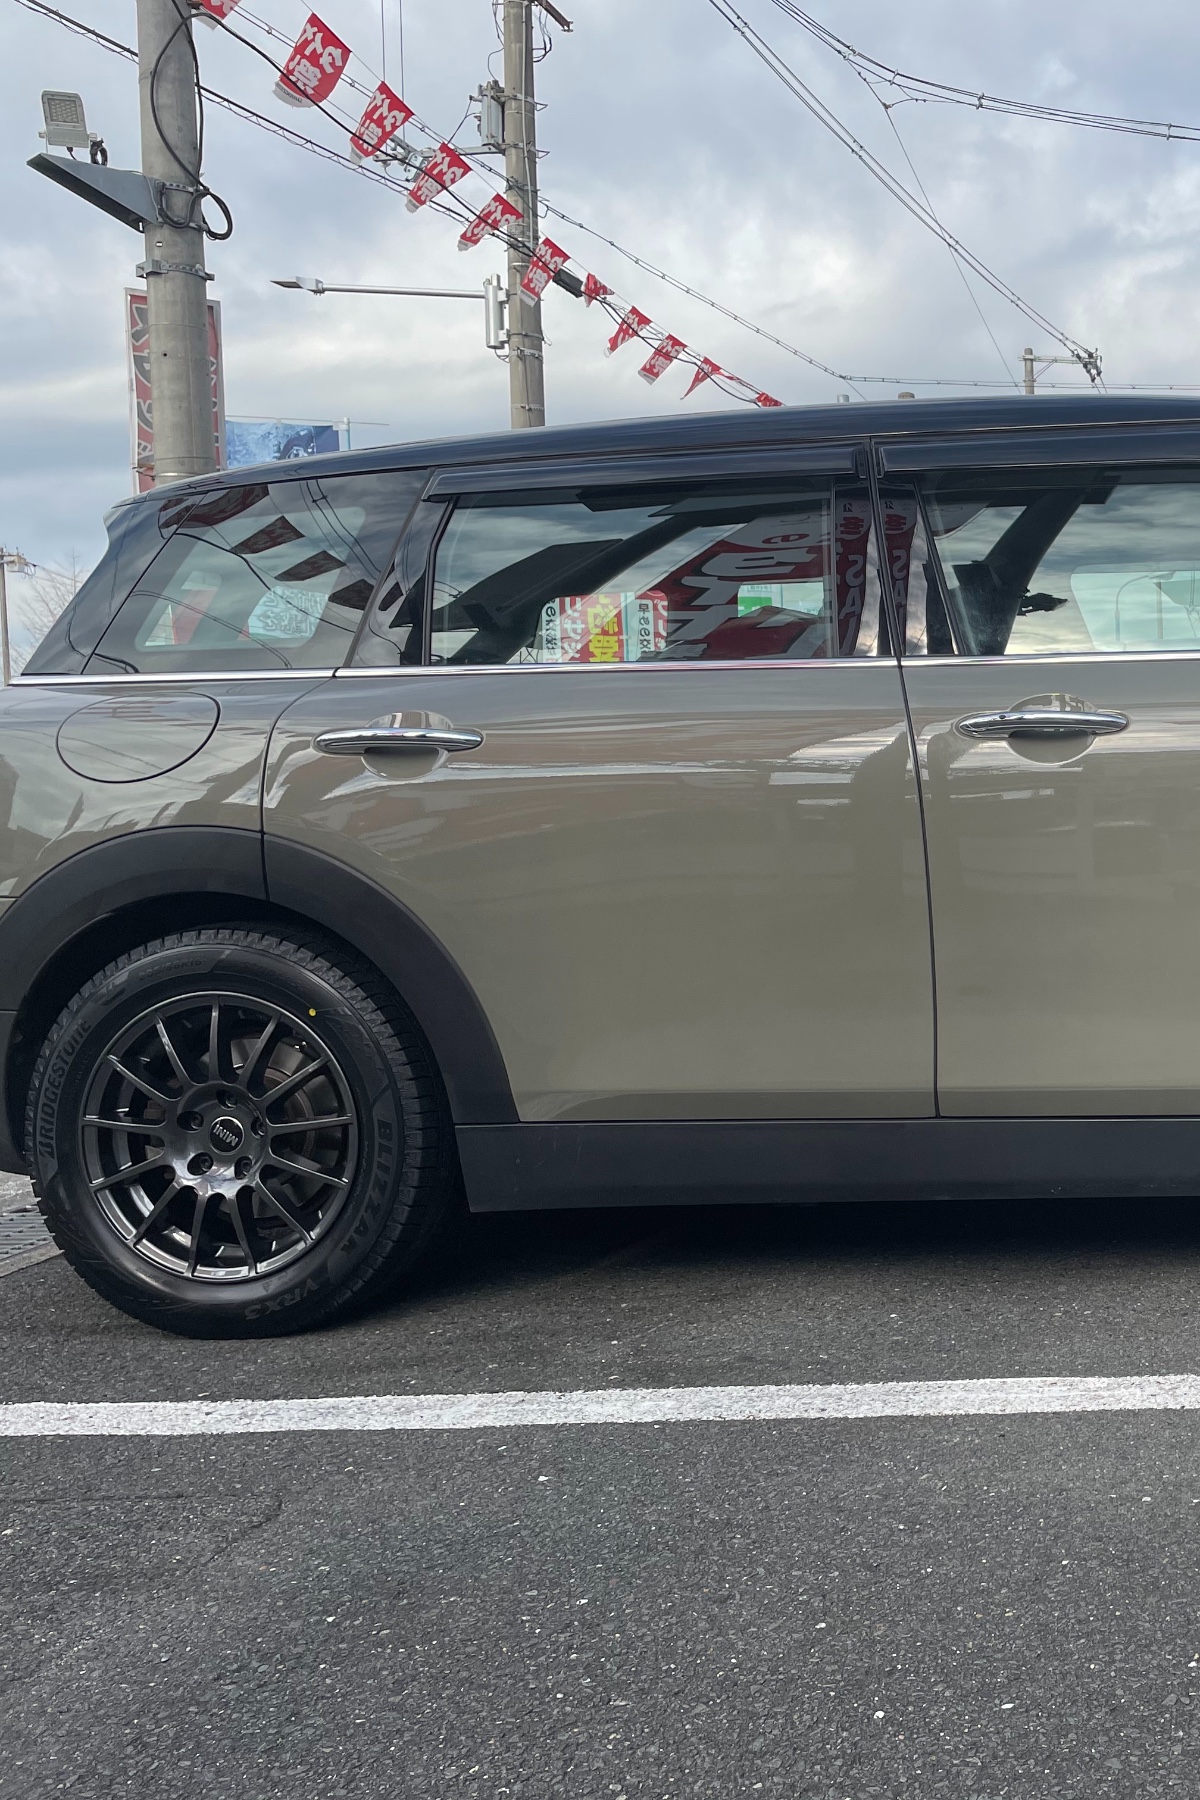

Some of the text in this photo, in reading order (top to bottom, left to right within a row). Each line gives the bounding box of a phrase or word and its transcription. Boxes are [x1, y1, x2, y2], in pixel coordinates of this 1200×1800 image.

[38, 1020, 92, 1160] BRIDGESTONE
[213, 1123, 239, 1147] MINI
[340, 1118, 394, 1255] BLIZZAK
